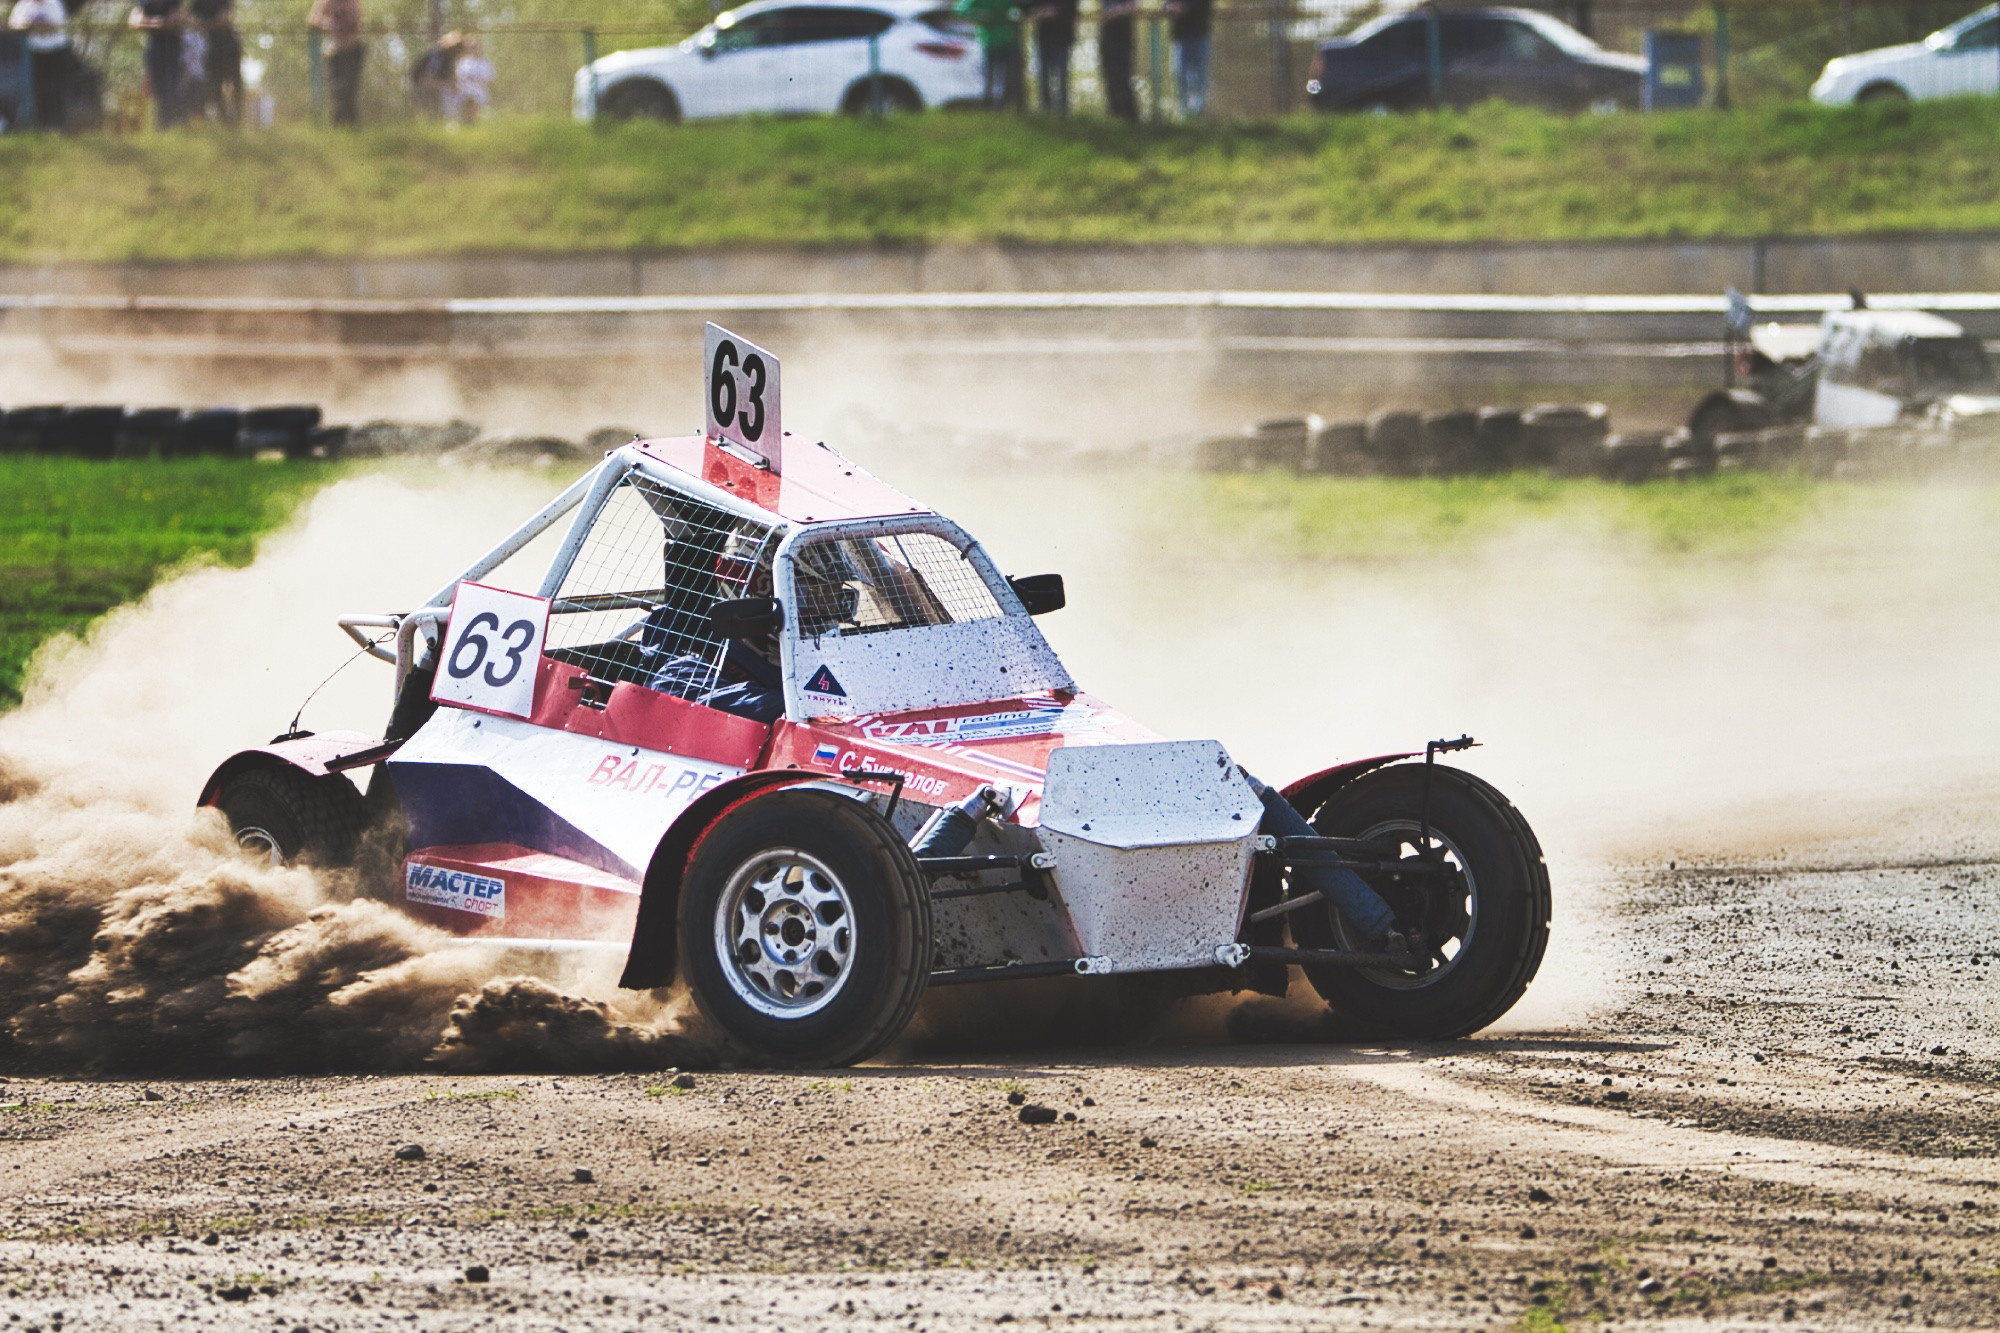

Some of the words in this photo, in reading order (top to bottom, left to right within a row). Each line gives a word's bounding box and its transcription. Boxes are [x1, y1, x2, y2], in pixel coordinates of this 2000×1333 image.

[711, 340, 766, 442] 63
[448, 612, 535, 687] 63
[807, 694, 844, 706] ТЯНУТЬ
[962, 711, 1031, 724] racing
[587, 755, 722, 801] ВАЛ-РЕ
[408, 865, 503, 899] МАСТЕР
